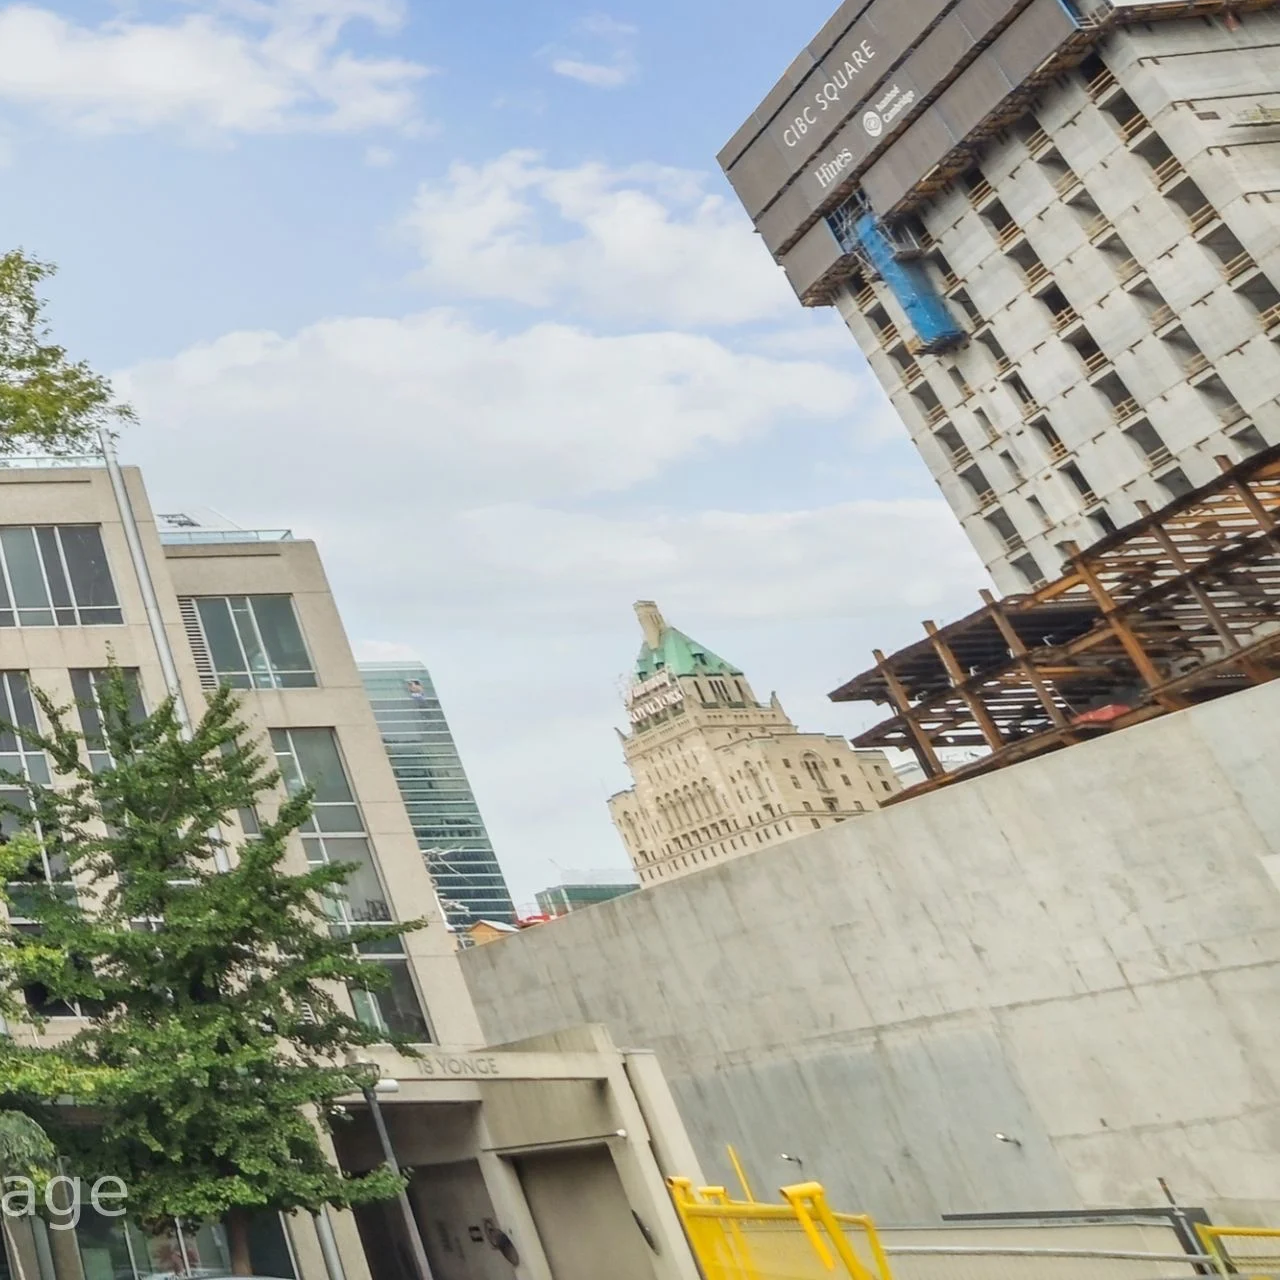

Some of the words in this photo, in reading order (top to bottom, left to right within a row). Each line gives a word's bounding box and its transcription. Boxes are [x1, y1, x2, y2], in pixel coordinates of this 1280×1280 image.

[783, 106, 817, 147] CIBC
[815, 39, 876, 111] SQUARE
[814, 147, 853, 189] Hines
[414, 1059, 434, 1075] 18
[436, 1057, 500, 1076] YONGE
